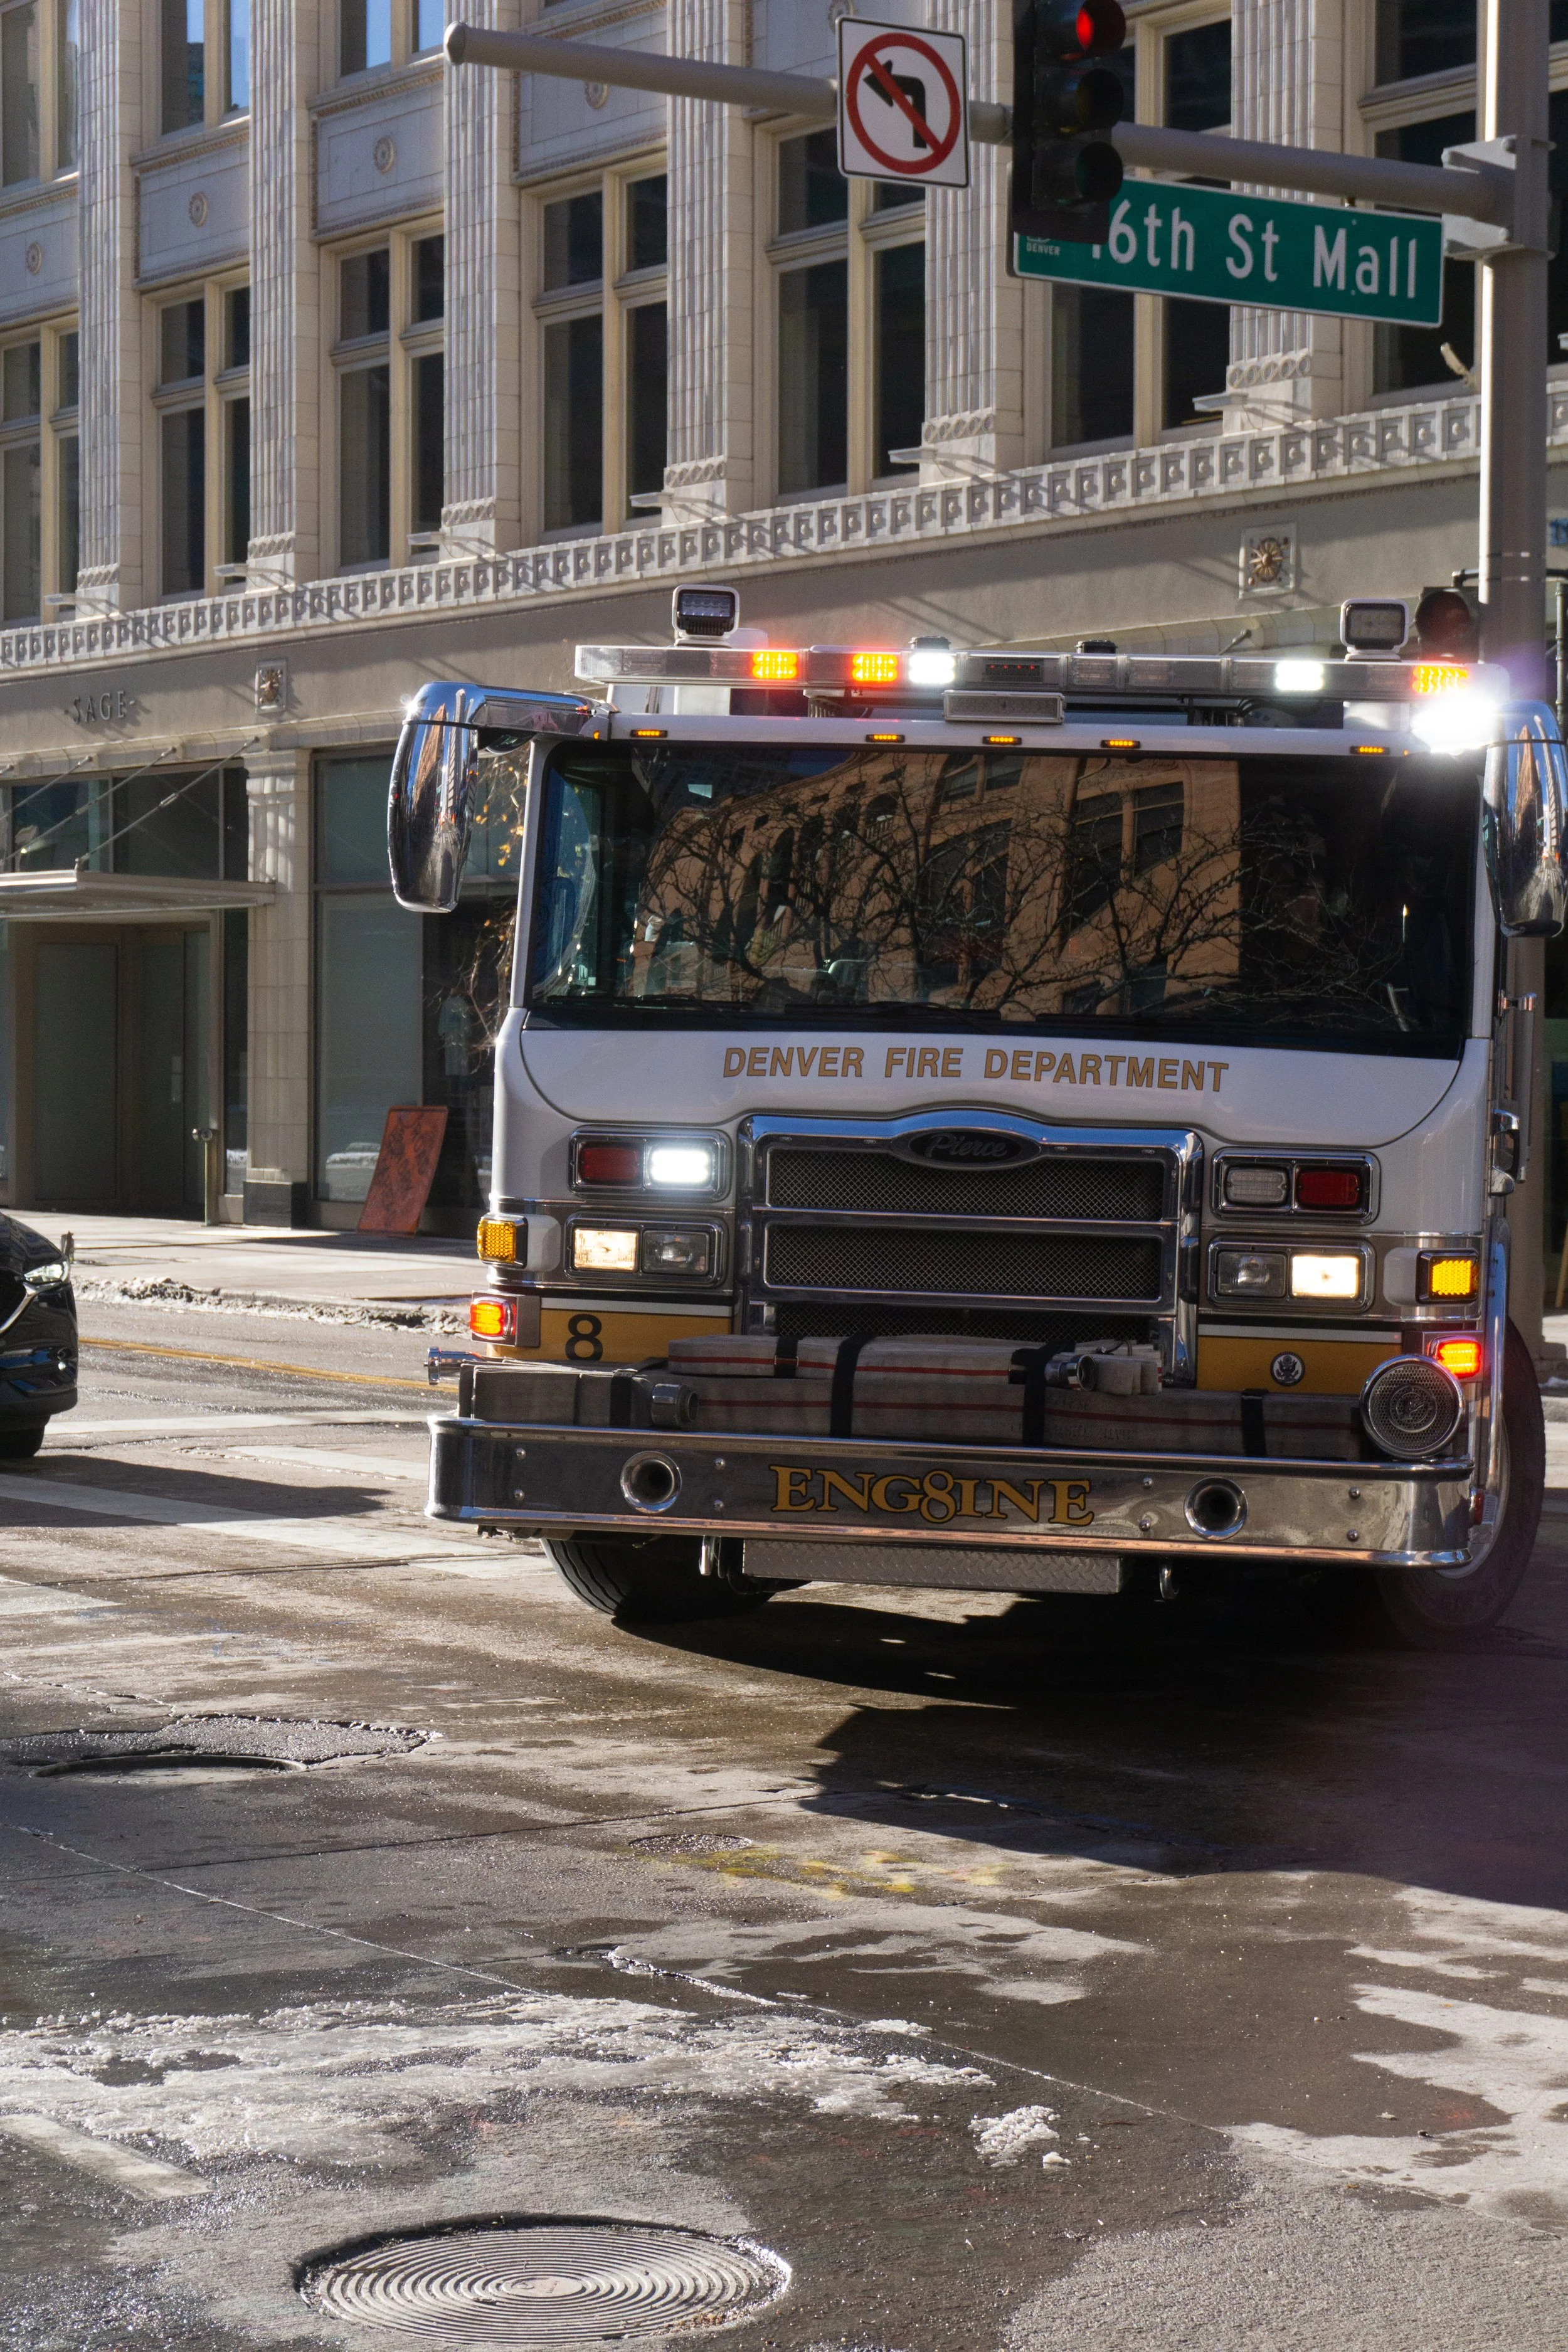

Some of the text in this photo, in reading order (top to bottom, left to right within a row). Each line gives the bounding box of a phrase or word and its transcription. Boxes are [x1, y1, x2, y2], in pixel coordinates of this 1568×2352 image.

[1026, 242, 1060, 257] DENVER
[1092, 199, 1417, 299] 6th St Mall
[723, 1047, 1229, 1093] DENVER FIRE DEPARTMENT
[924, 1133, 1007, 1158] Pierce
[565, 1313, 603, 1361] 8
